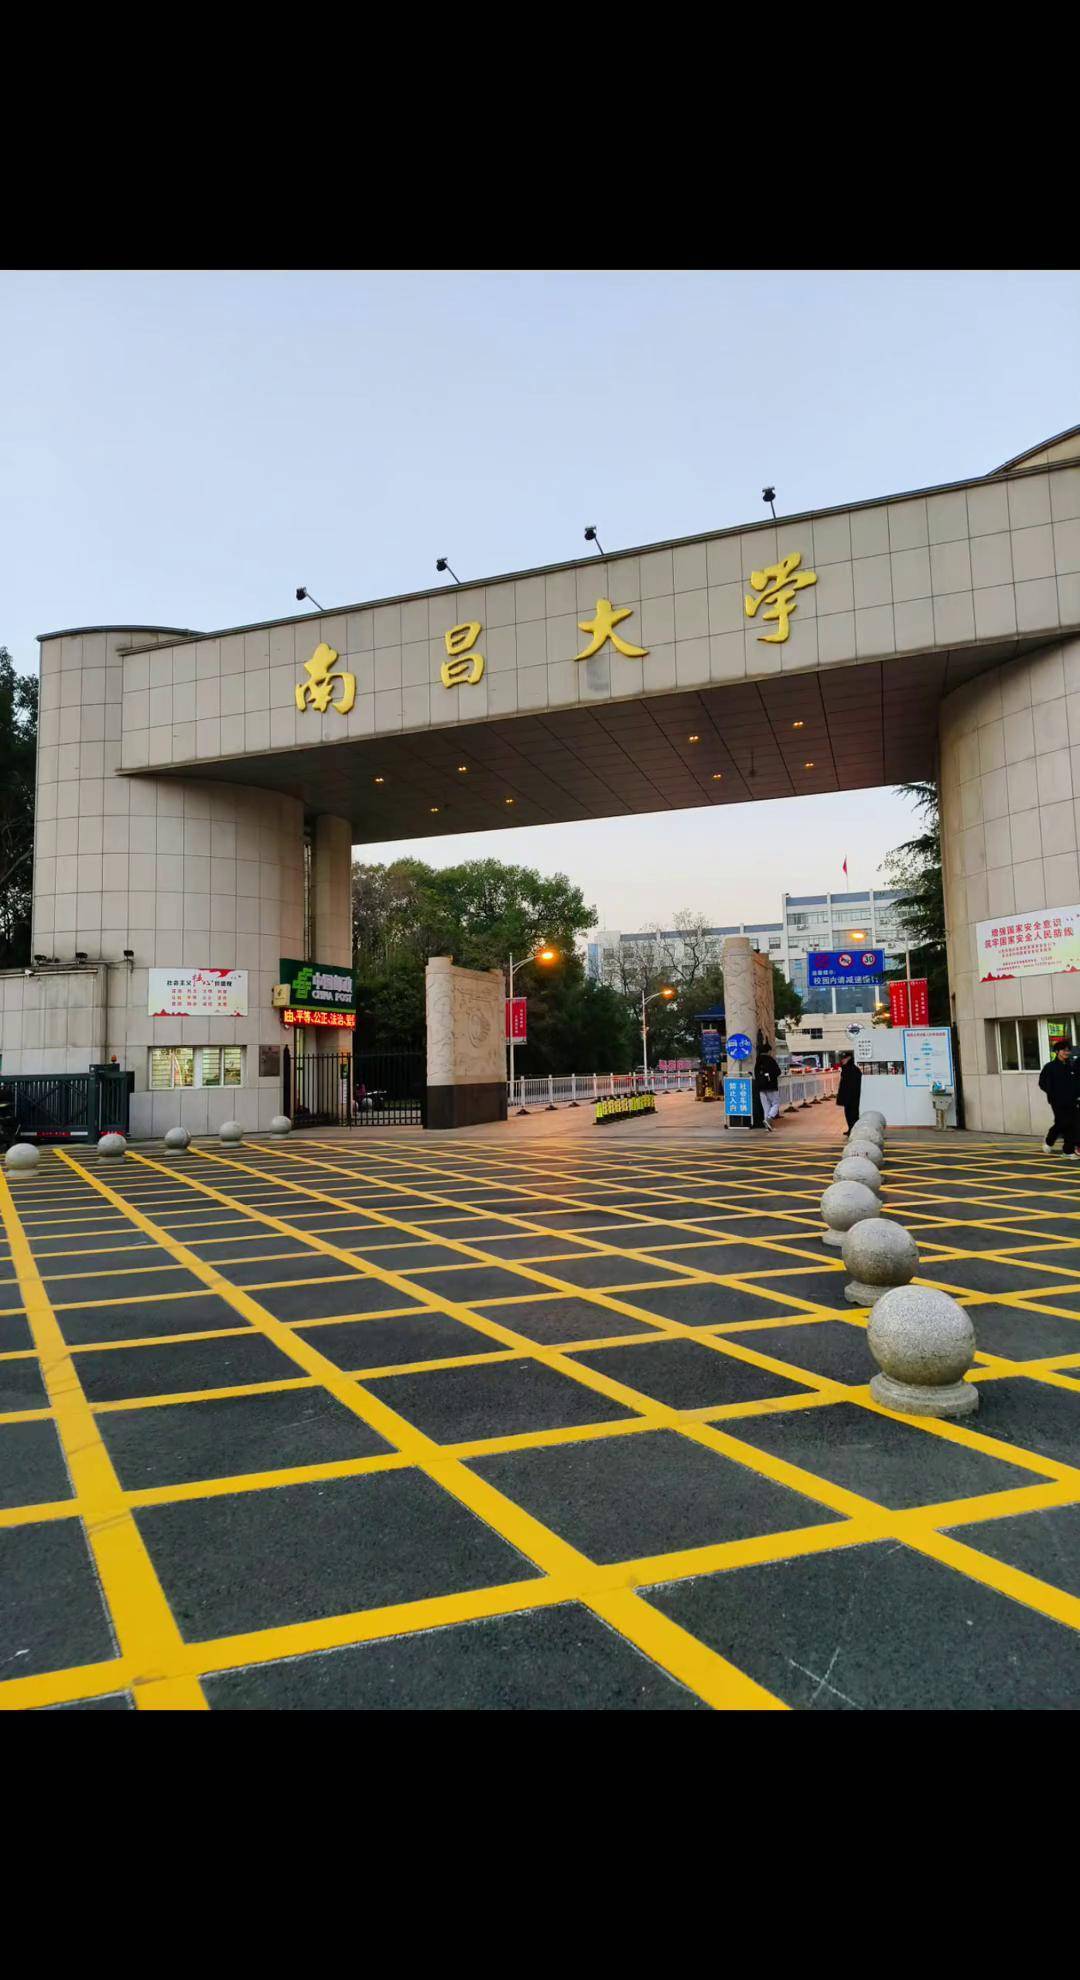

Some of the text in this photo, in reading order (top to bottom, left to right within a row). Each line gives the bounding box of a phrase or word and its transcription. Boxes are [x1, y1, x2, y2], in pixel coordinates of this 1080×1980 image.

[295, 551, 818, 714] 南昌大学
[991, 918, 1062, 937] 增强国家安全意识
[311, 990, 353, 1003] CHINA POST
